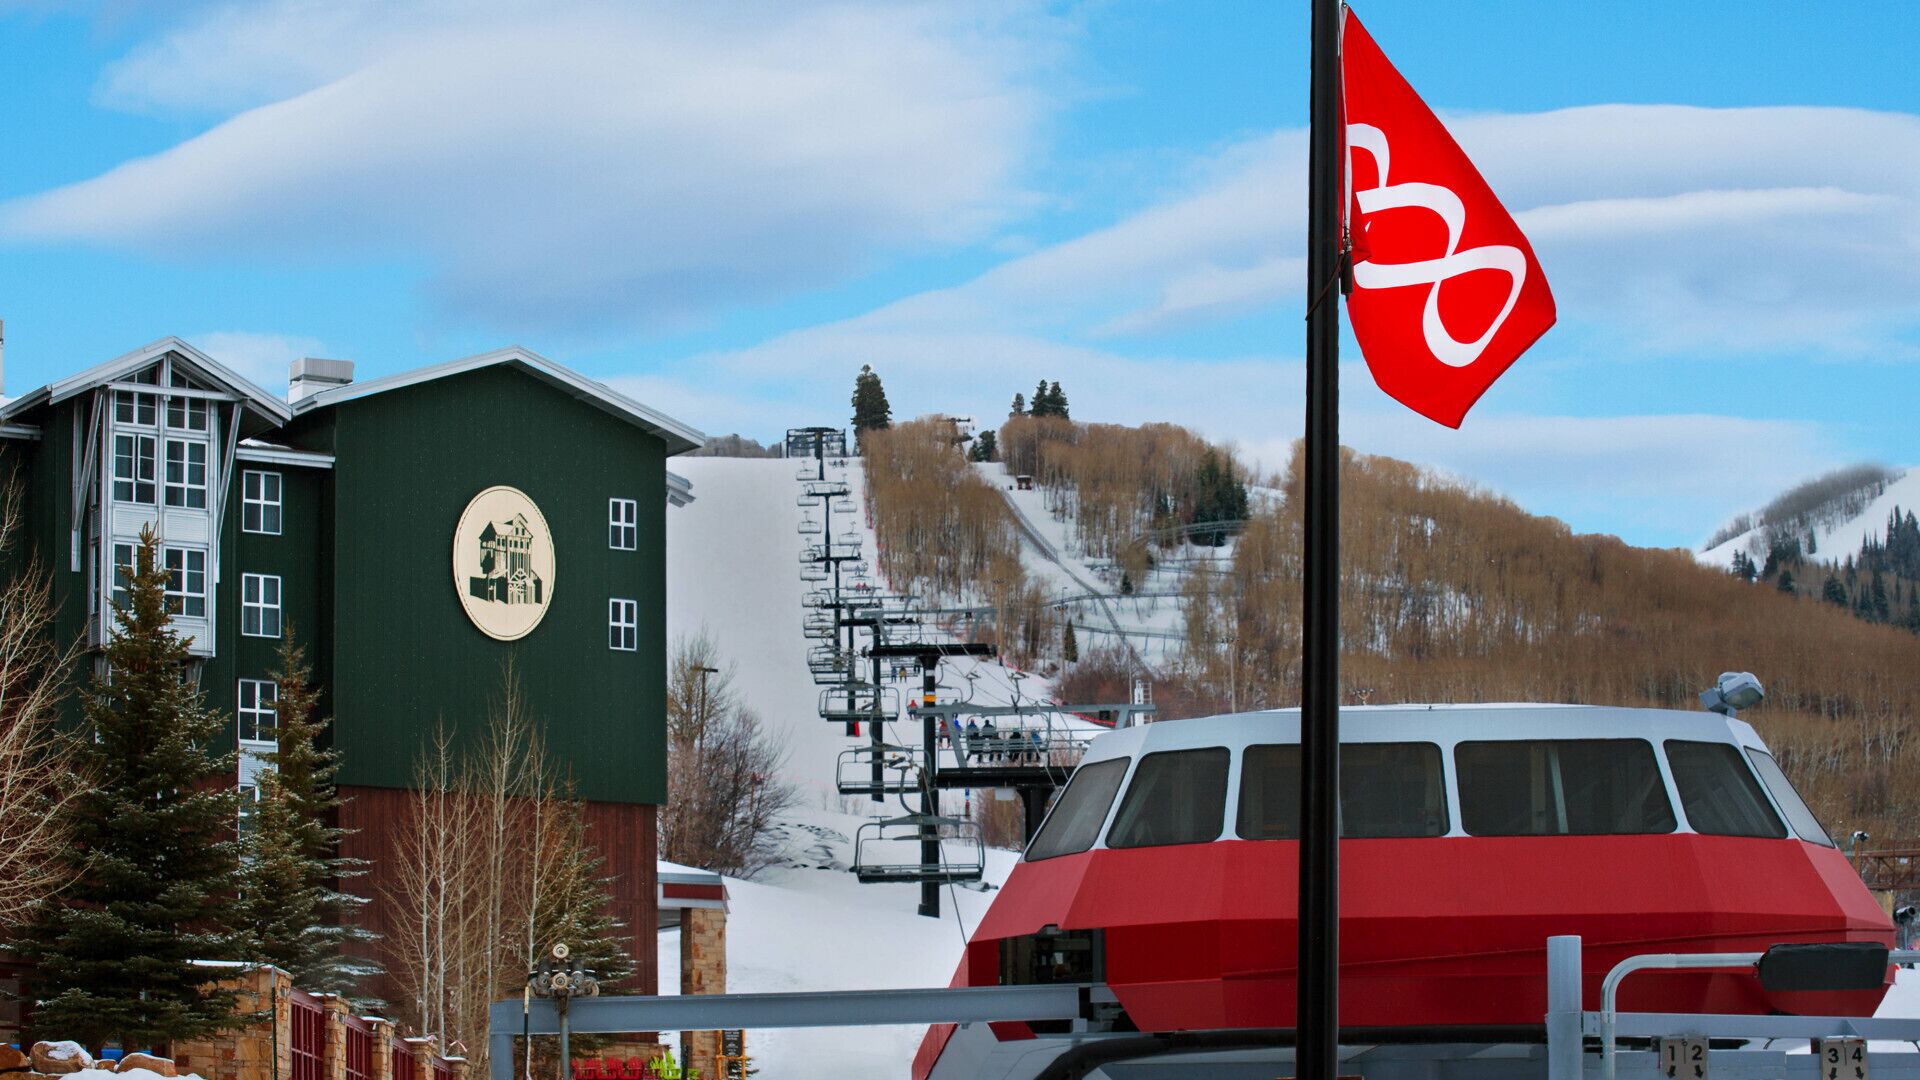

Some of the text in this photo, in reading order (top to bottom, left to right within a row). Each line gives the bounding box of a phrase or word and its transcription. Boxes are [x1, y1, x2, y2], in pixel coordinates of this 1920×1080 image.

[1668, 1045, 1702, 1061] 1 2
[1828, 1047, 1863, 1064] 3 4
